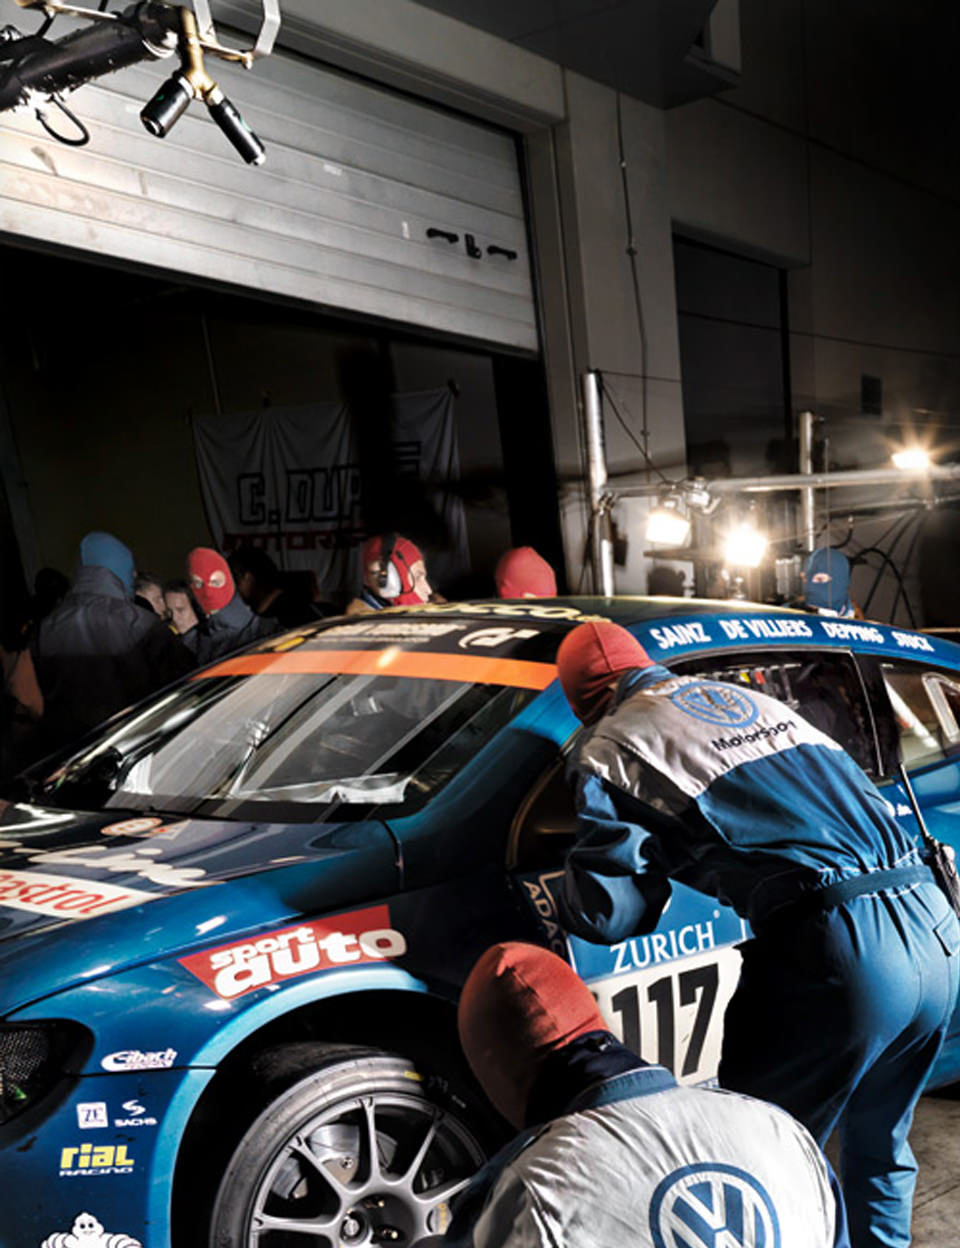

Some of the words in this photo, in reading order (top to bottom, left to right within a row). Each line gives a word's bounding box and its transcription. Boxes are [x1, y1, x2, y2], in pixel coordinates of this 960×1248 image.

[650, 622, 712, 650] SAINZ
[719, 620, 748, 640] DE
[749, 619, 813, 639] VILLIERS
[820, 621, 885, 644] DEPPING
[0, 873, 128, 915] astrol
[522, 880, 566, 956] ADAC
[209, 927, 315, 970] sport
[214, 929, 407, 998] auto
[610, 921, 715, 974] ZURICH
[611, 963, 719, 1078] 117
